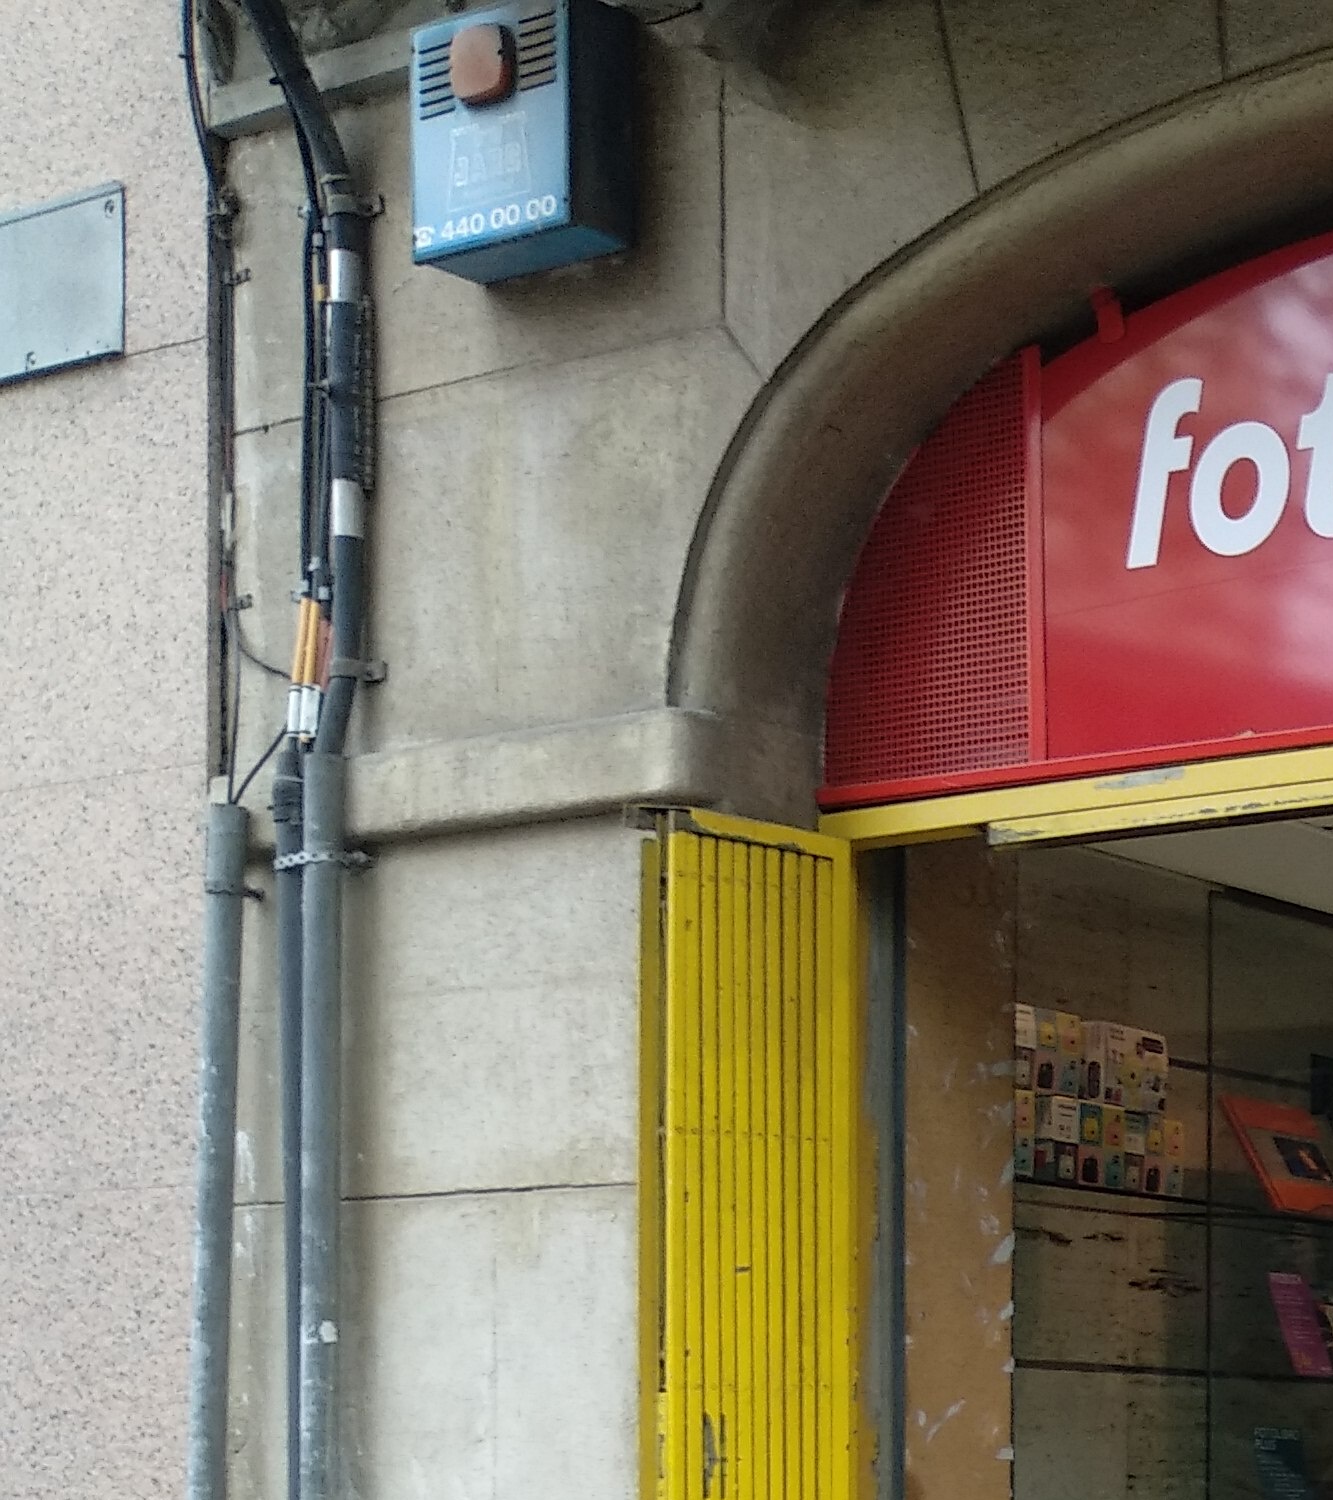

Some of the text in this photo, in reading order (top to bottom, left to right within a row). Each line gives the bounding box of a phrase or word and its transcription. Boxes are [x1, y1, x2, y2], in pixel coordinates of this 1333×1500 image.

[440, 194, 557, 242] 440 00 00
